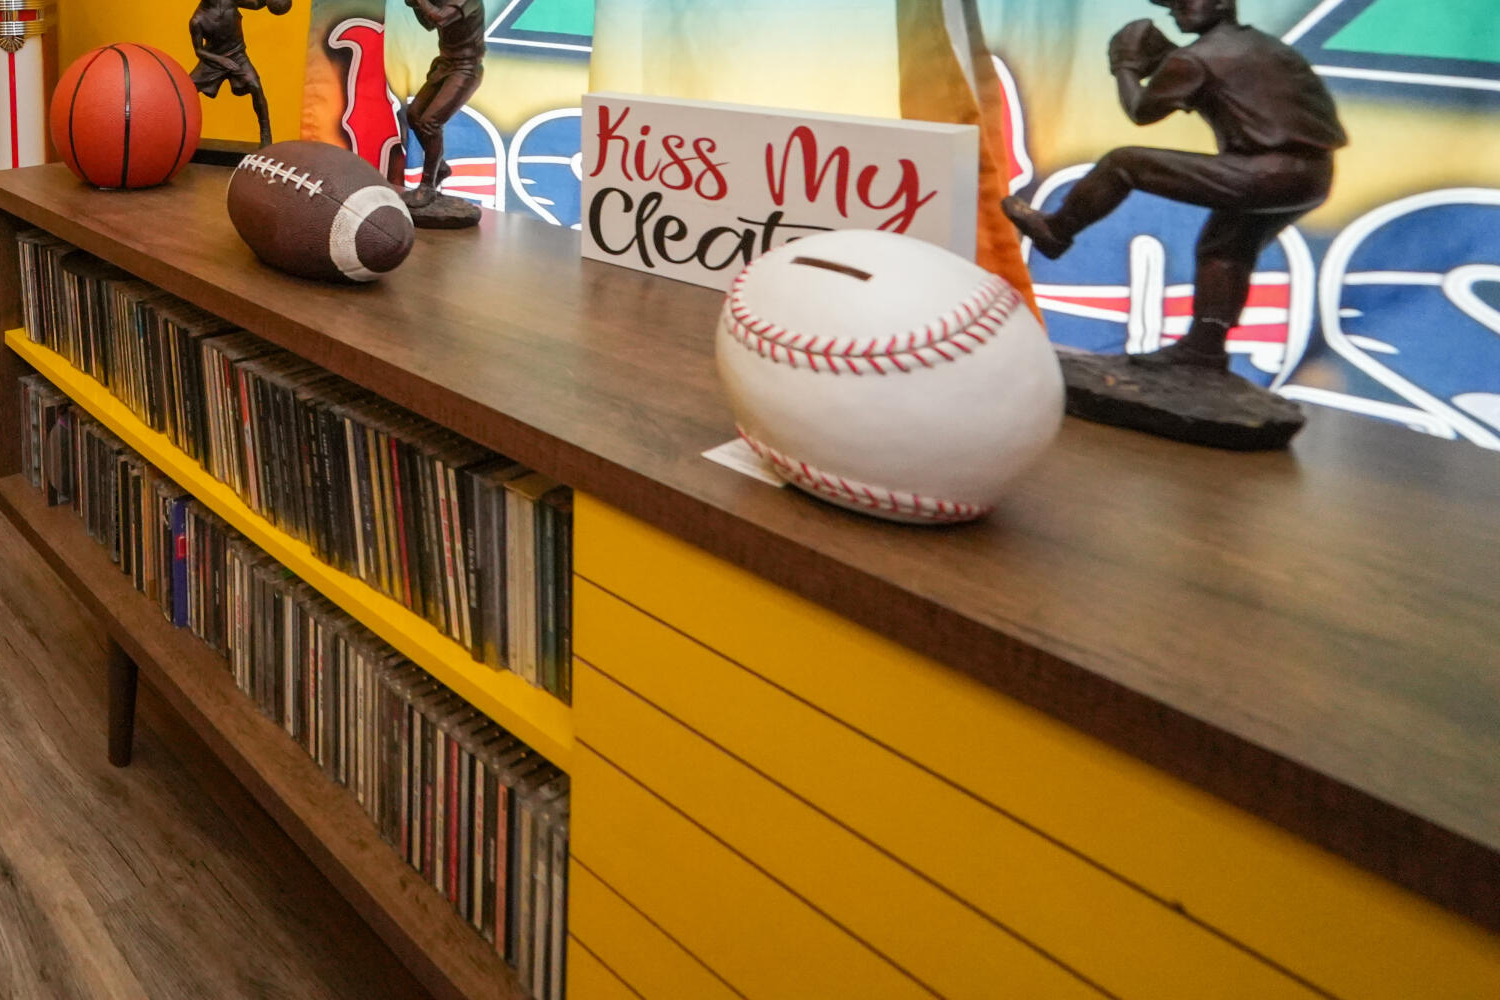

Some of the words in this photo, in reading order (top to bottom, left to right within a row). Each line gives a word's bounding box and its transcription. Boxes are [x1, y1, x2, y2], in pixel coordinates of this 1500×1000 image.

[589, 105, 731, 201] Kiss
[765, 125, 938, 233] My
[588, 187, 838, 271] Cleat
